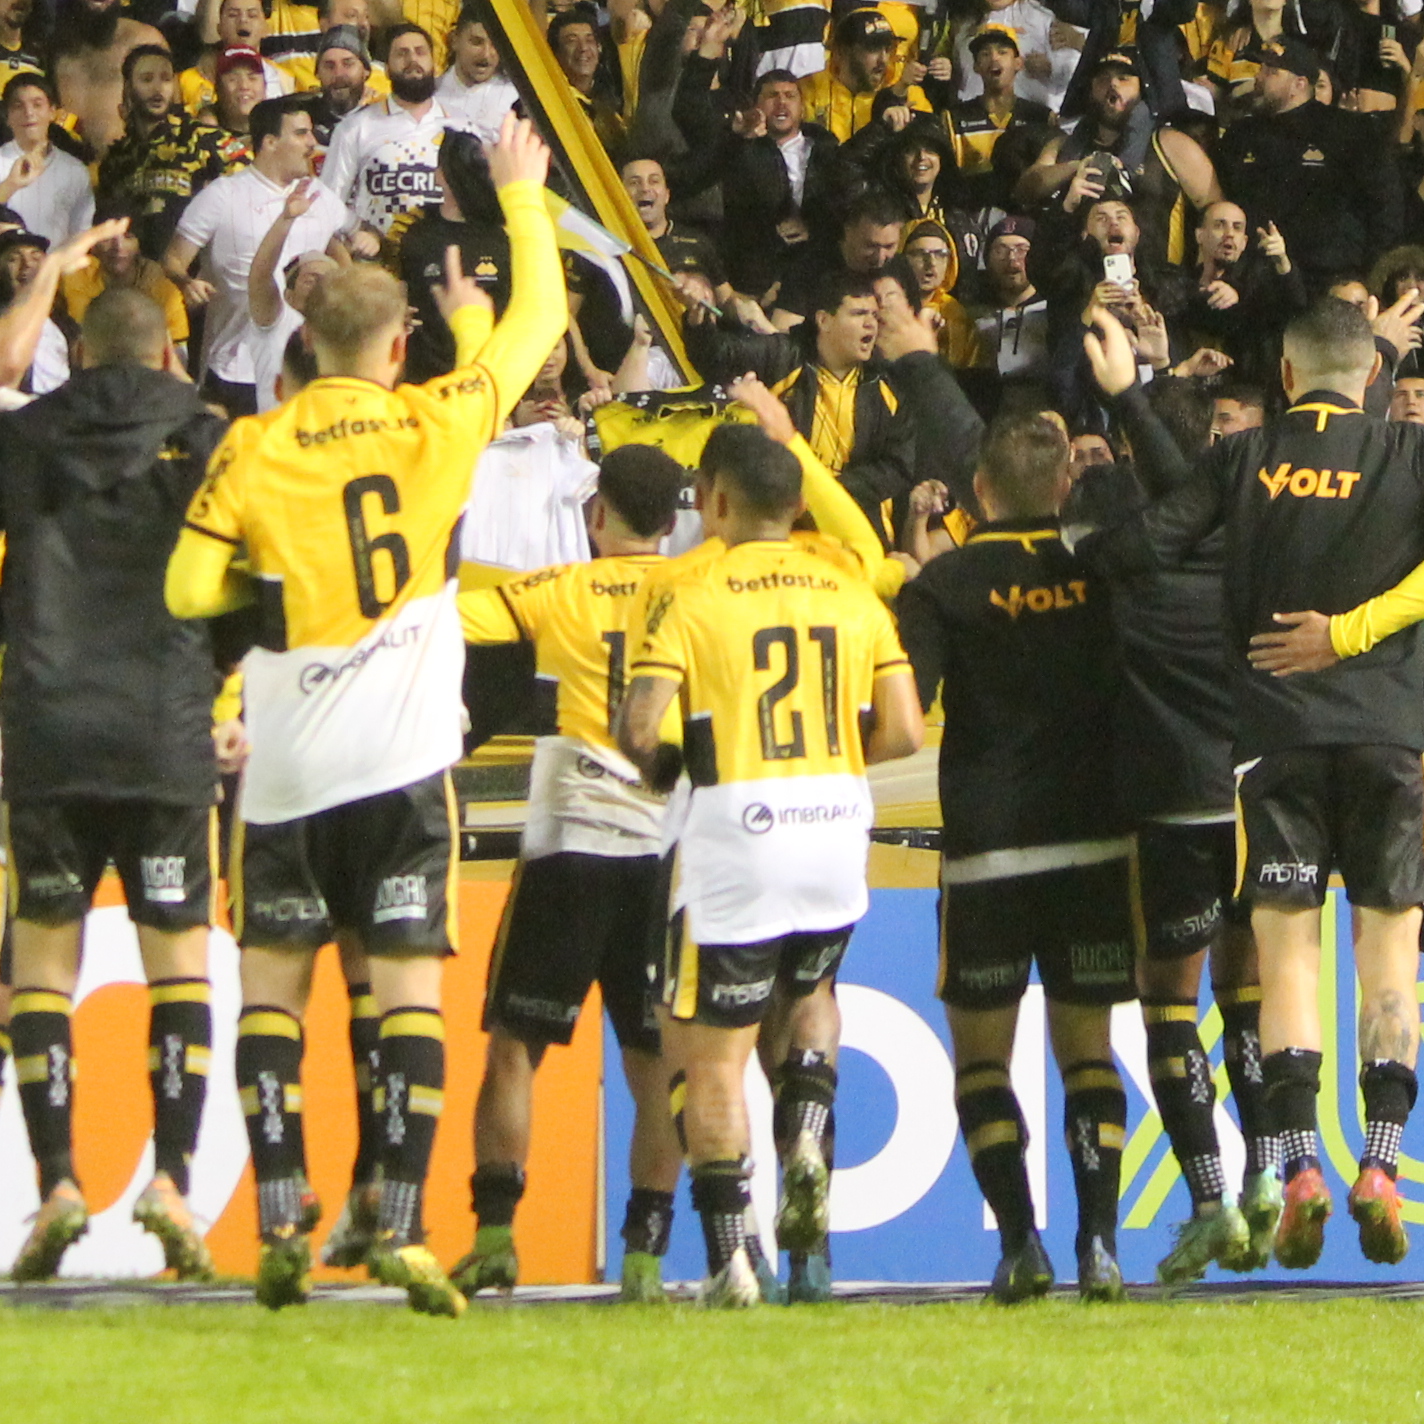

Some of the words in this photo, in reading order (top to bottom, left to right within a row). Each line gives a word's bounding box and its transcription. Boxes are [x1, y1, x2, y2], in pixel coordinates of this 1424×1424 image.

[371, 171, 444, 194] CECRI
[1257, 462, 1362, 501] VOLT
[342, 474, 415, 619] 6
[989, 579, 1088, 621] VOLT
[601, 631, 626, 736] 1
[752, 625, 842, 762] 21
